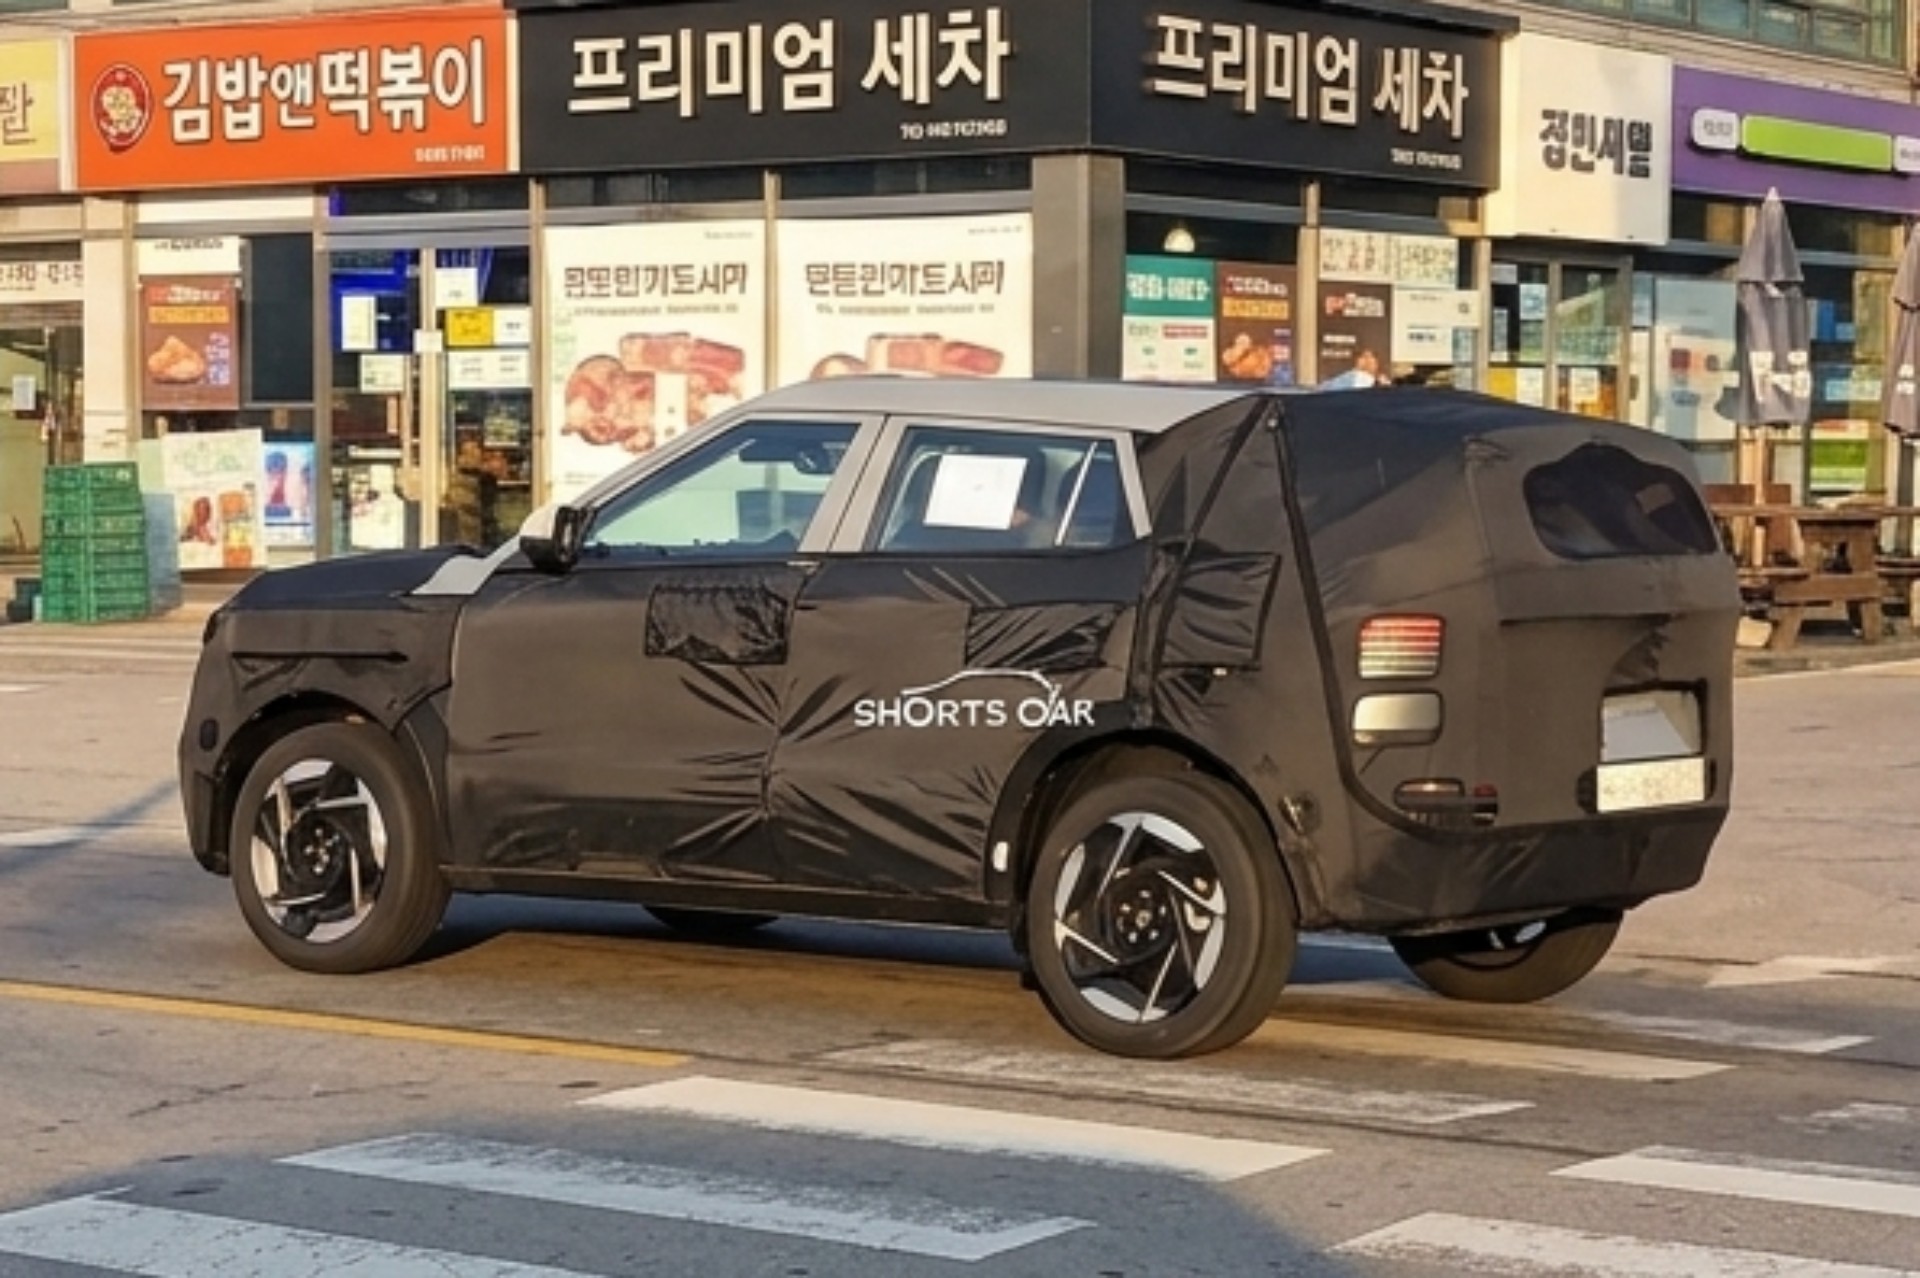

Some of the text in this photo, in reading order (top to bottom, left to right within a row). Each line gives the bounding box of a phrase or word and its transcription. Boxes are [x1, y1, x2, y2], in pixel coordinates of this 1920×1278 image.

[163, 37, 485, 143] 김밥앤떡볶이
[567, 7, 1010, 118] 프리미엄 세차
[1152, 14, 1470, 138] 프리미엄 세차
